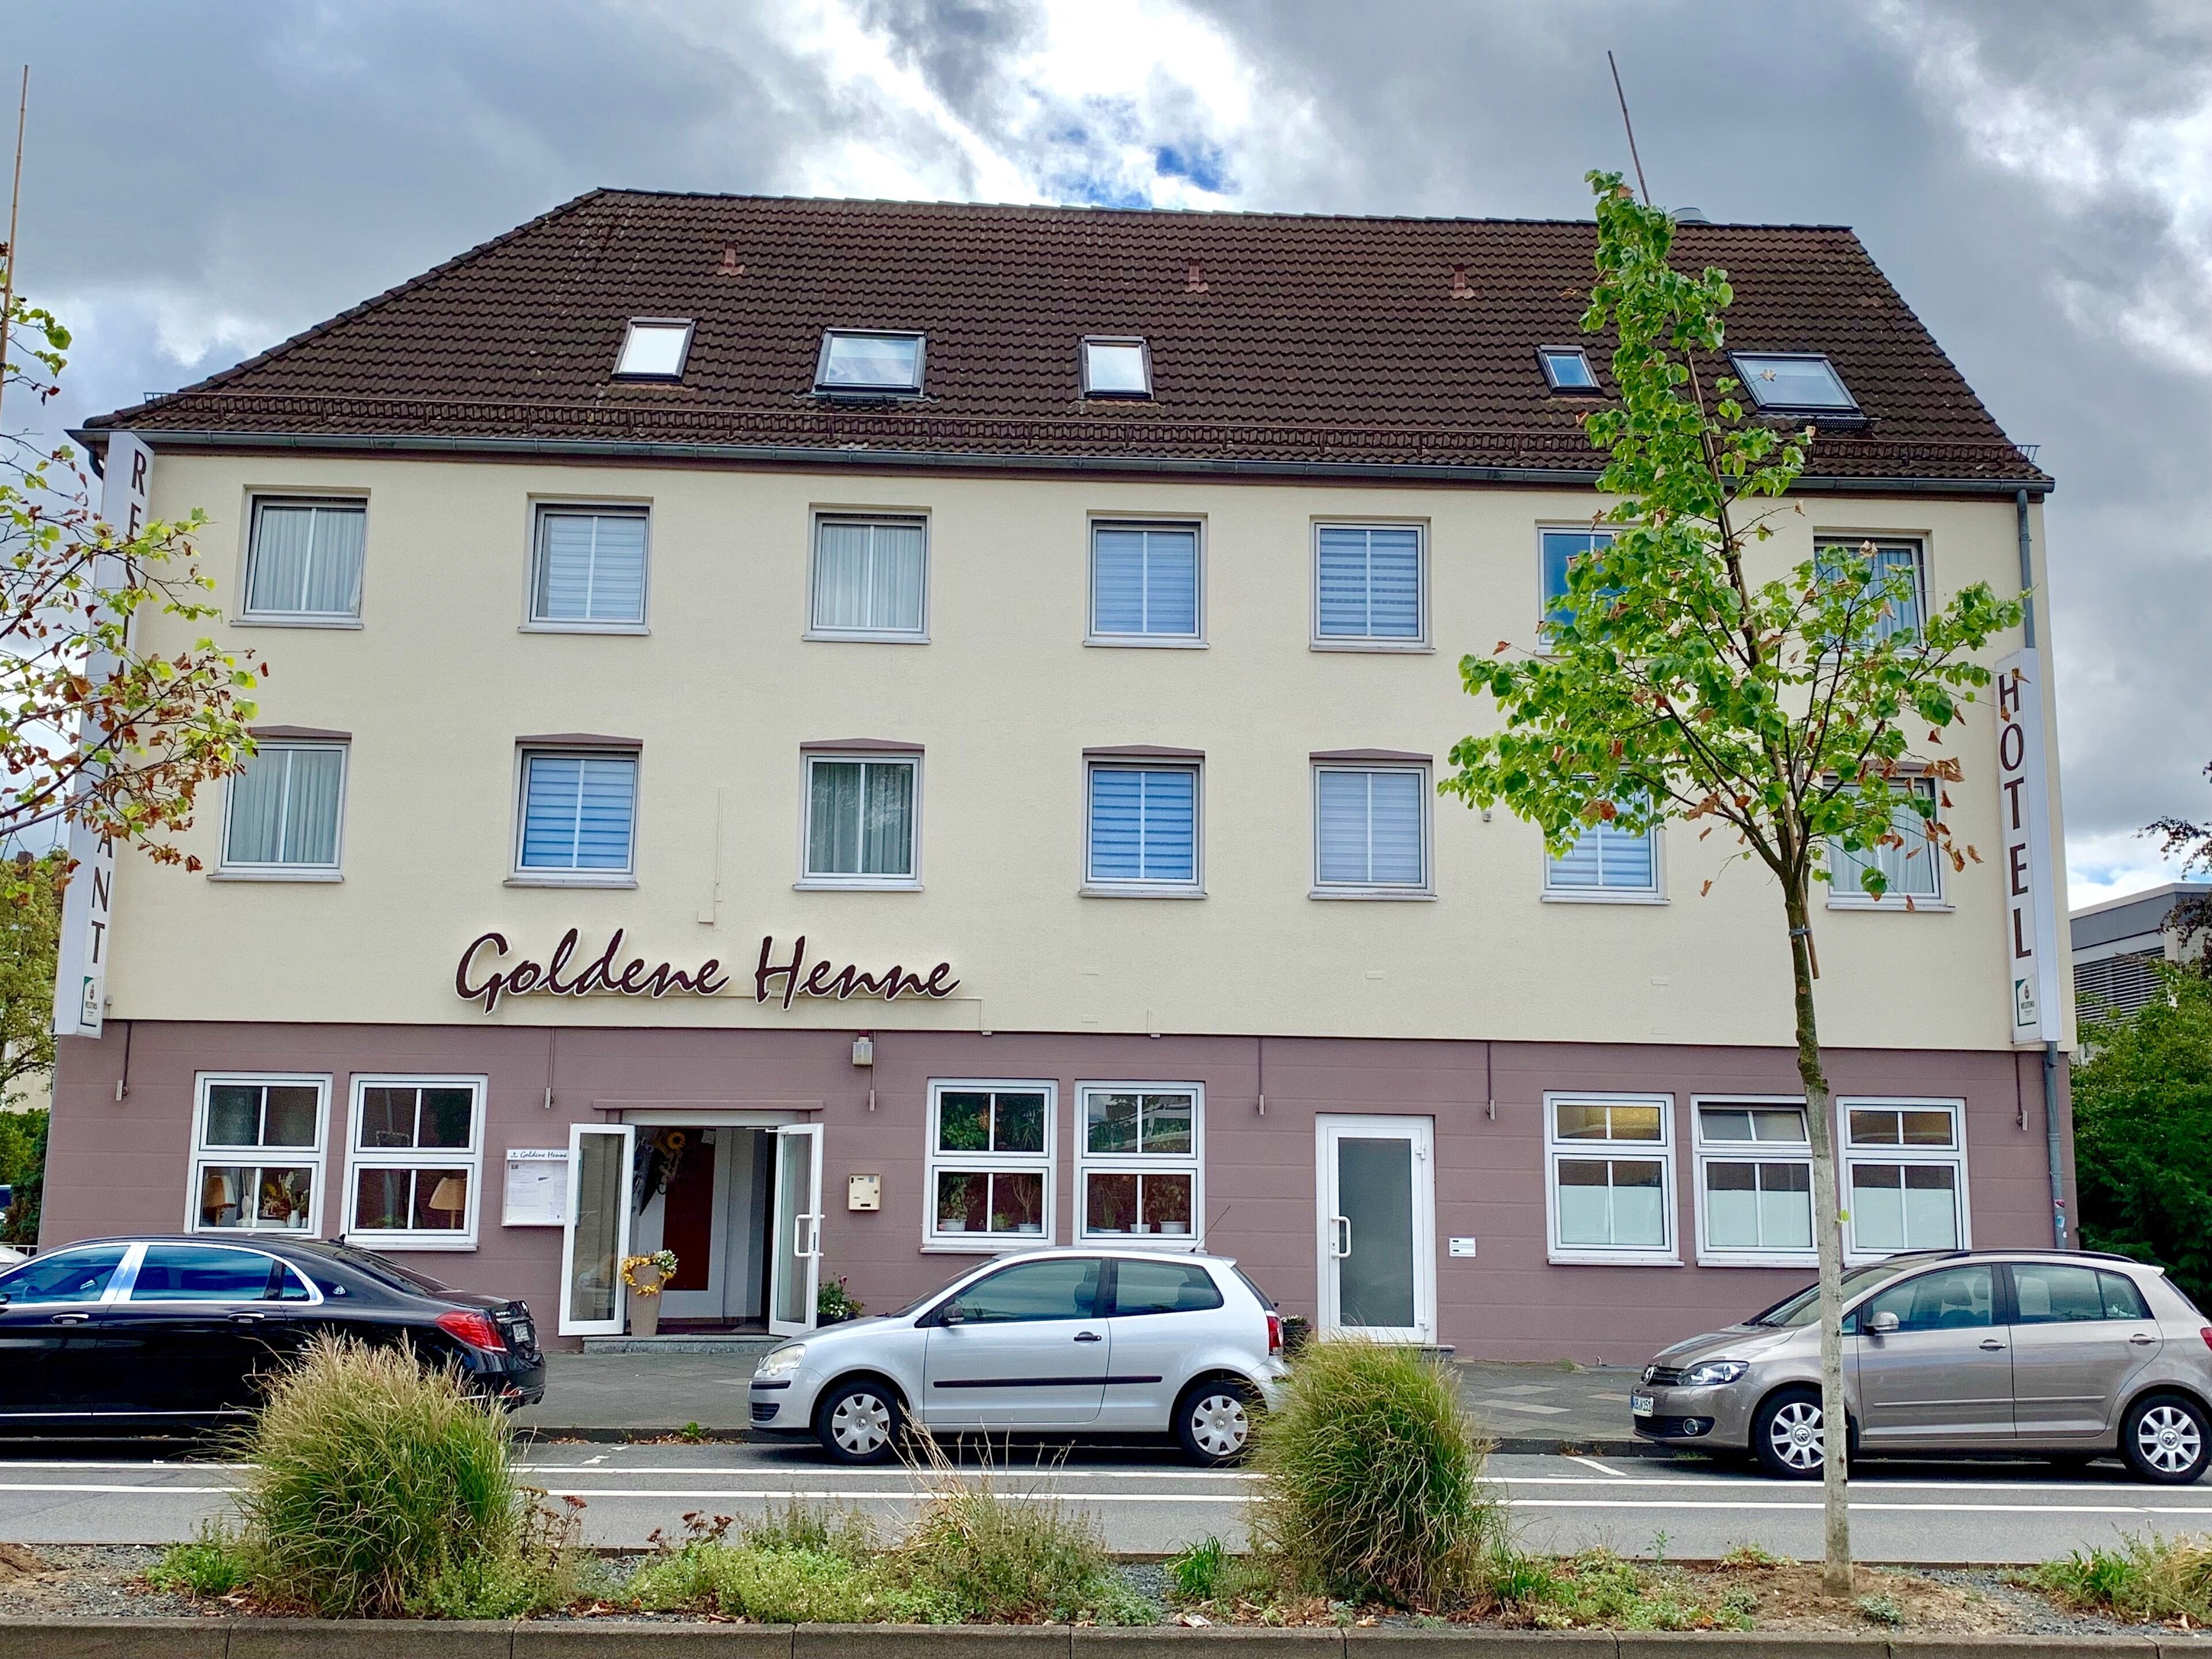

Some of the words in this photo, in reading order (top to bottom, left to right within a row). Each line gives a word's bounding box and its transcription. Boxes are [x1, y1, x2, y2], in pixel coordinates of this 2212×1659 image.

[1998, 671, 2032, 959] HOTEL
[455, 928, 729, 1015] Goldene
[755, 935, 961, 1010] Henne
[548, 1150, 567, 1158] Henne
